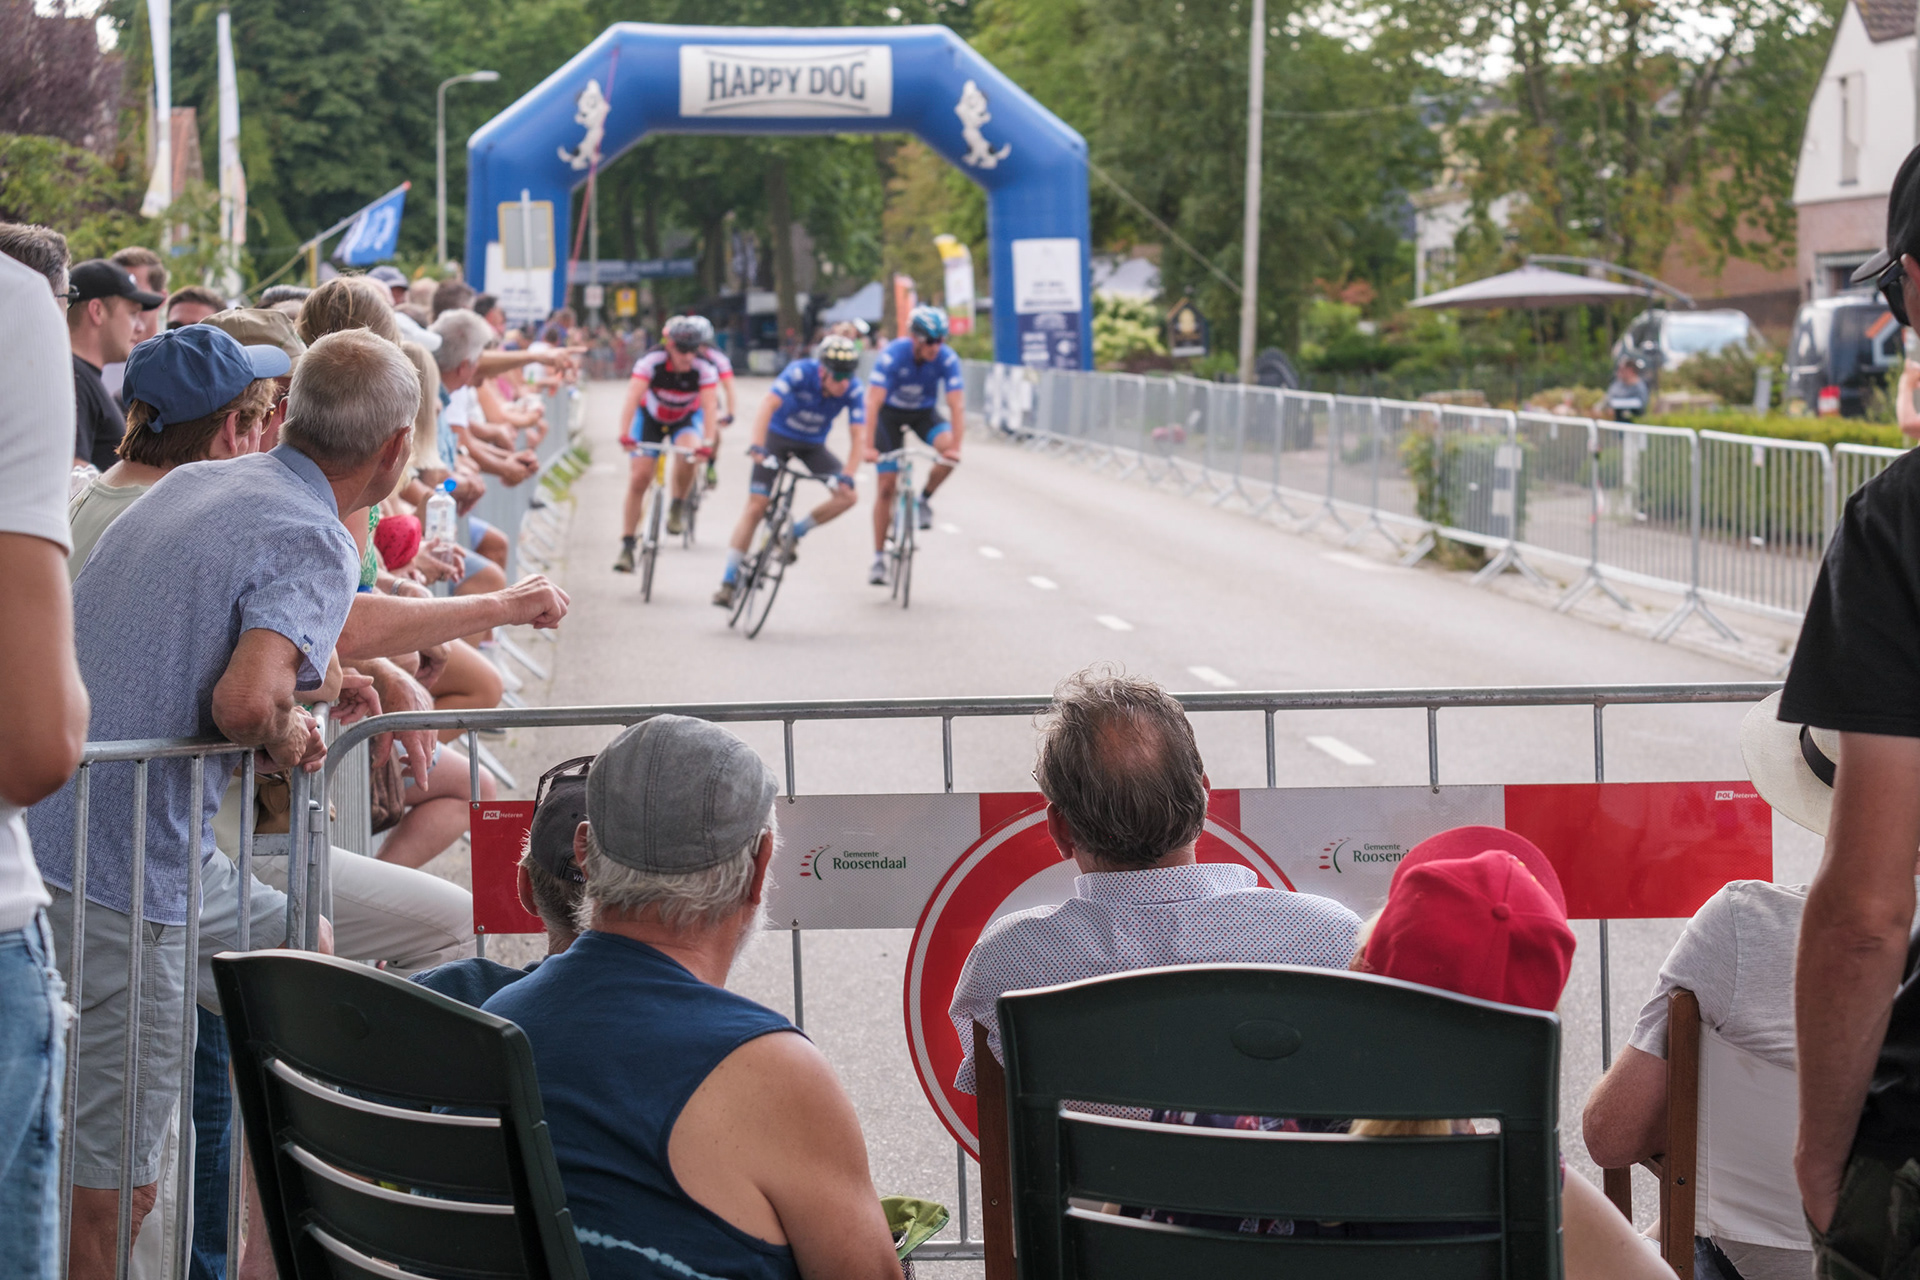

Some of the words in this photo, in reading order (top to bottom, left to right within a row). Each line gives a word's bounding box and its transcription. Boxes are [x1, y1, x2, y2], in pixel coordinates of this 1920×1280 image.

[708, 60, 802, 102] HAPPY
[809, 61, 866, 101] DOG
[484, 811, 499, 819] POL
[1363, 843, 1401, 851] Gemeente
[843, 850, 880, 858] Gemeente
[832, 856, 907, 870] Roosendaal
